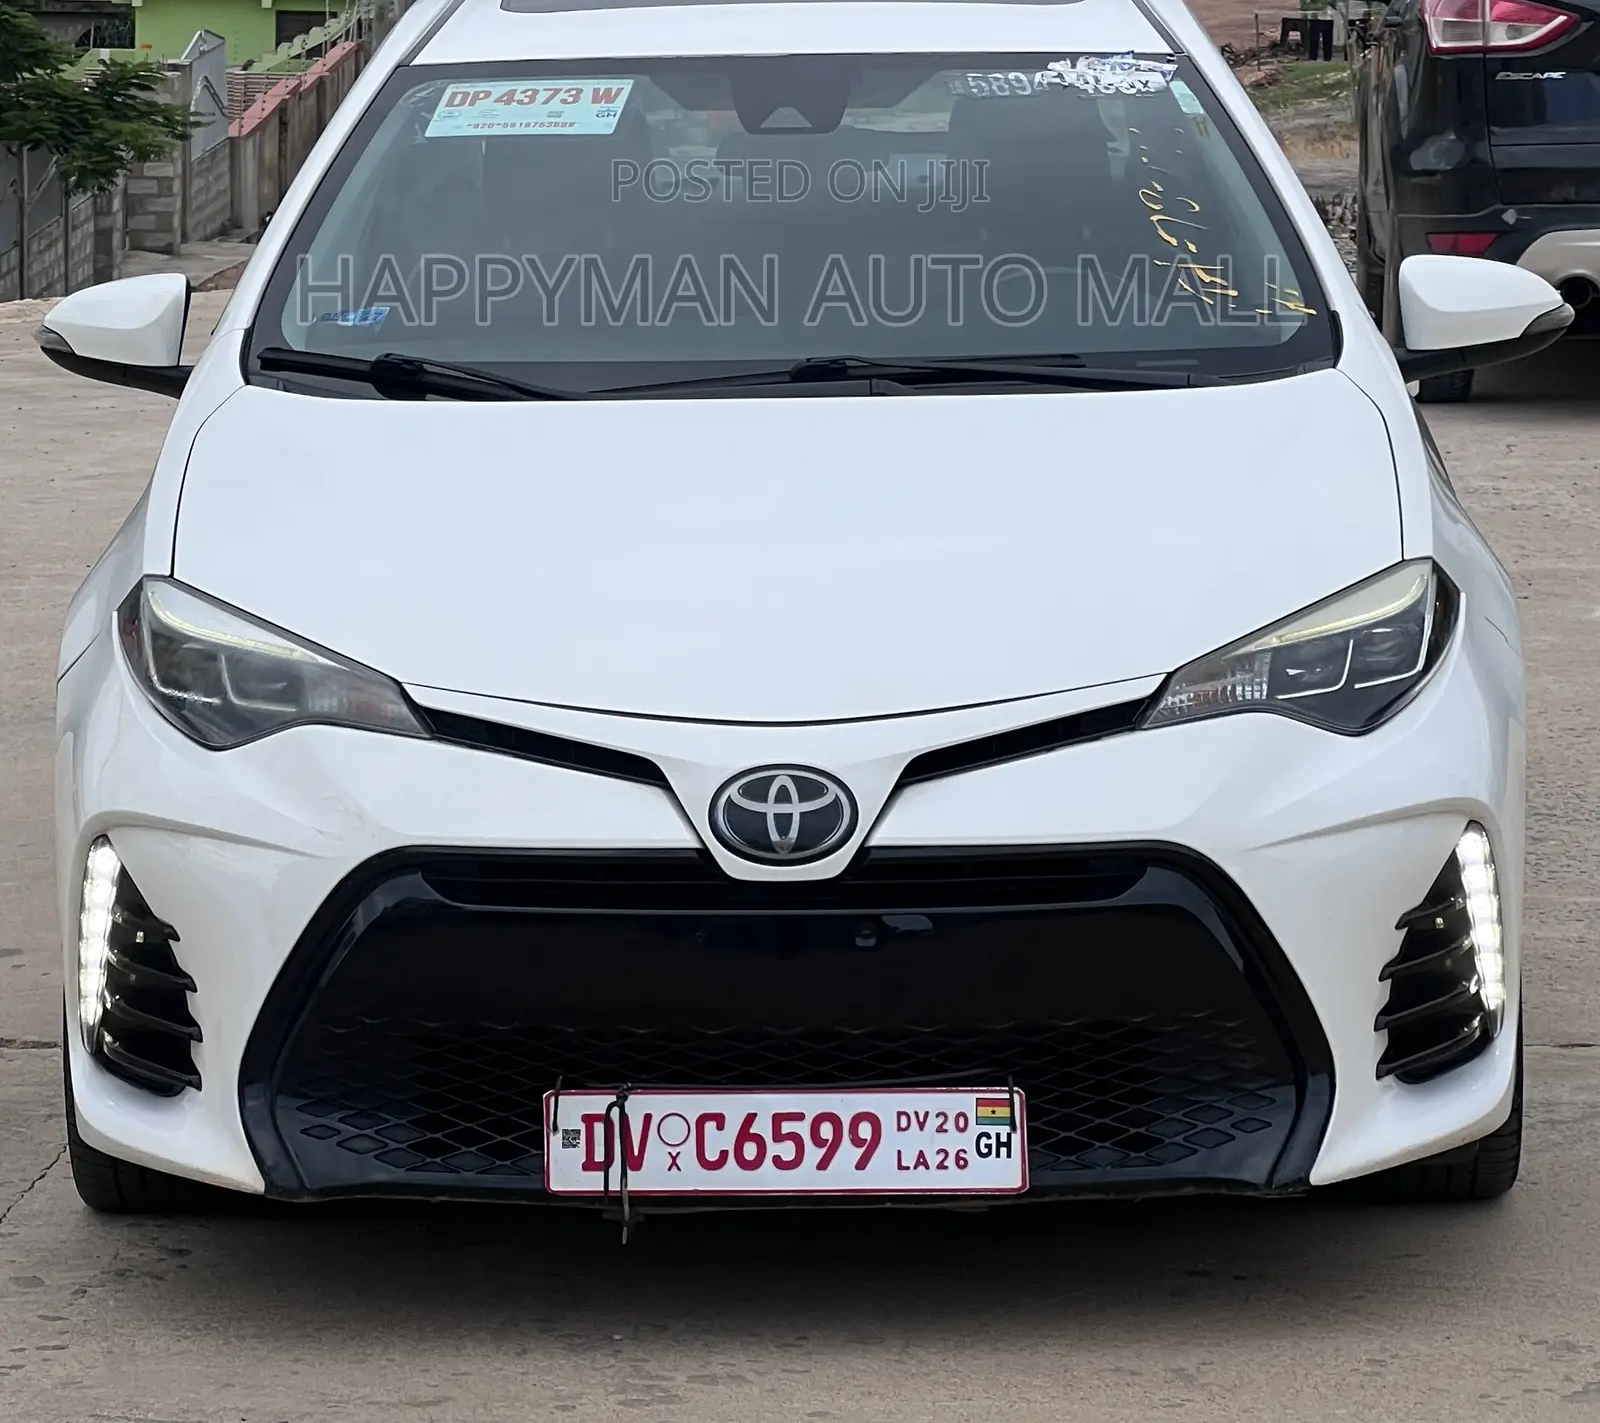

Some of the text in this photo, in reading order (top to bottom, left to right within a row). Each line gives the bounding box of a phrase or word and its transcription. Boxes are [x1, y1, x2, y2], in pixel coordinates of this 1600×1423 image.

[444, 86, 625, 108] DP 4373 W
[695, 1111, 882, 1172] C6599
[975, 1131, 1013, 1159] GH
